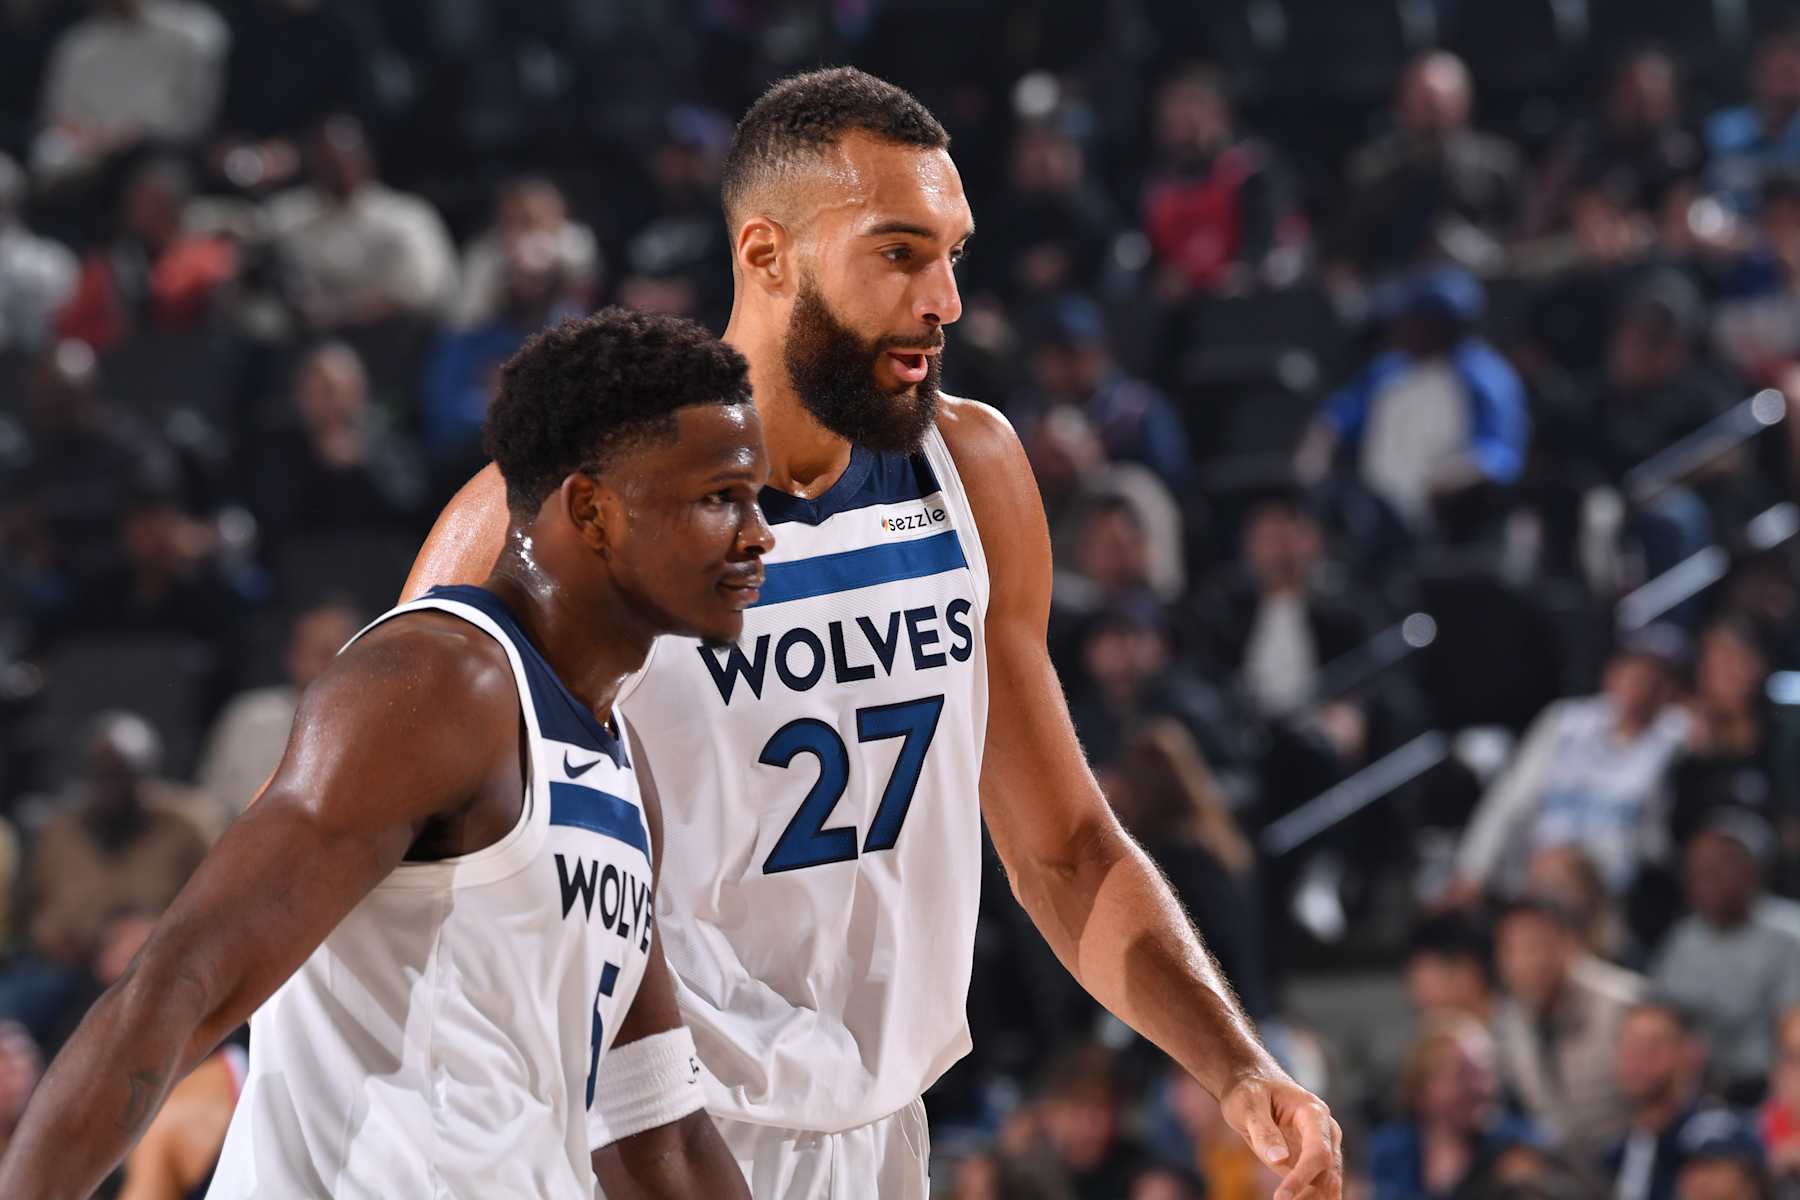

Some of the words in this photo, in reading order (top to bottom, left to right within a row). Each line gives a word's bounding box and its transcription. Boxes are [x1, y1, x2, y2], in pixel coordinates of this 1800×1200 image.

[888, 507, 946, 532] sezzle
[697, 598, 973, 706] WOLVES
[758, 694, 945, 875] 27
